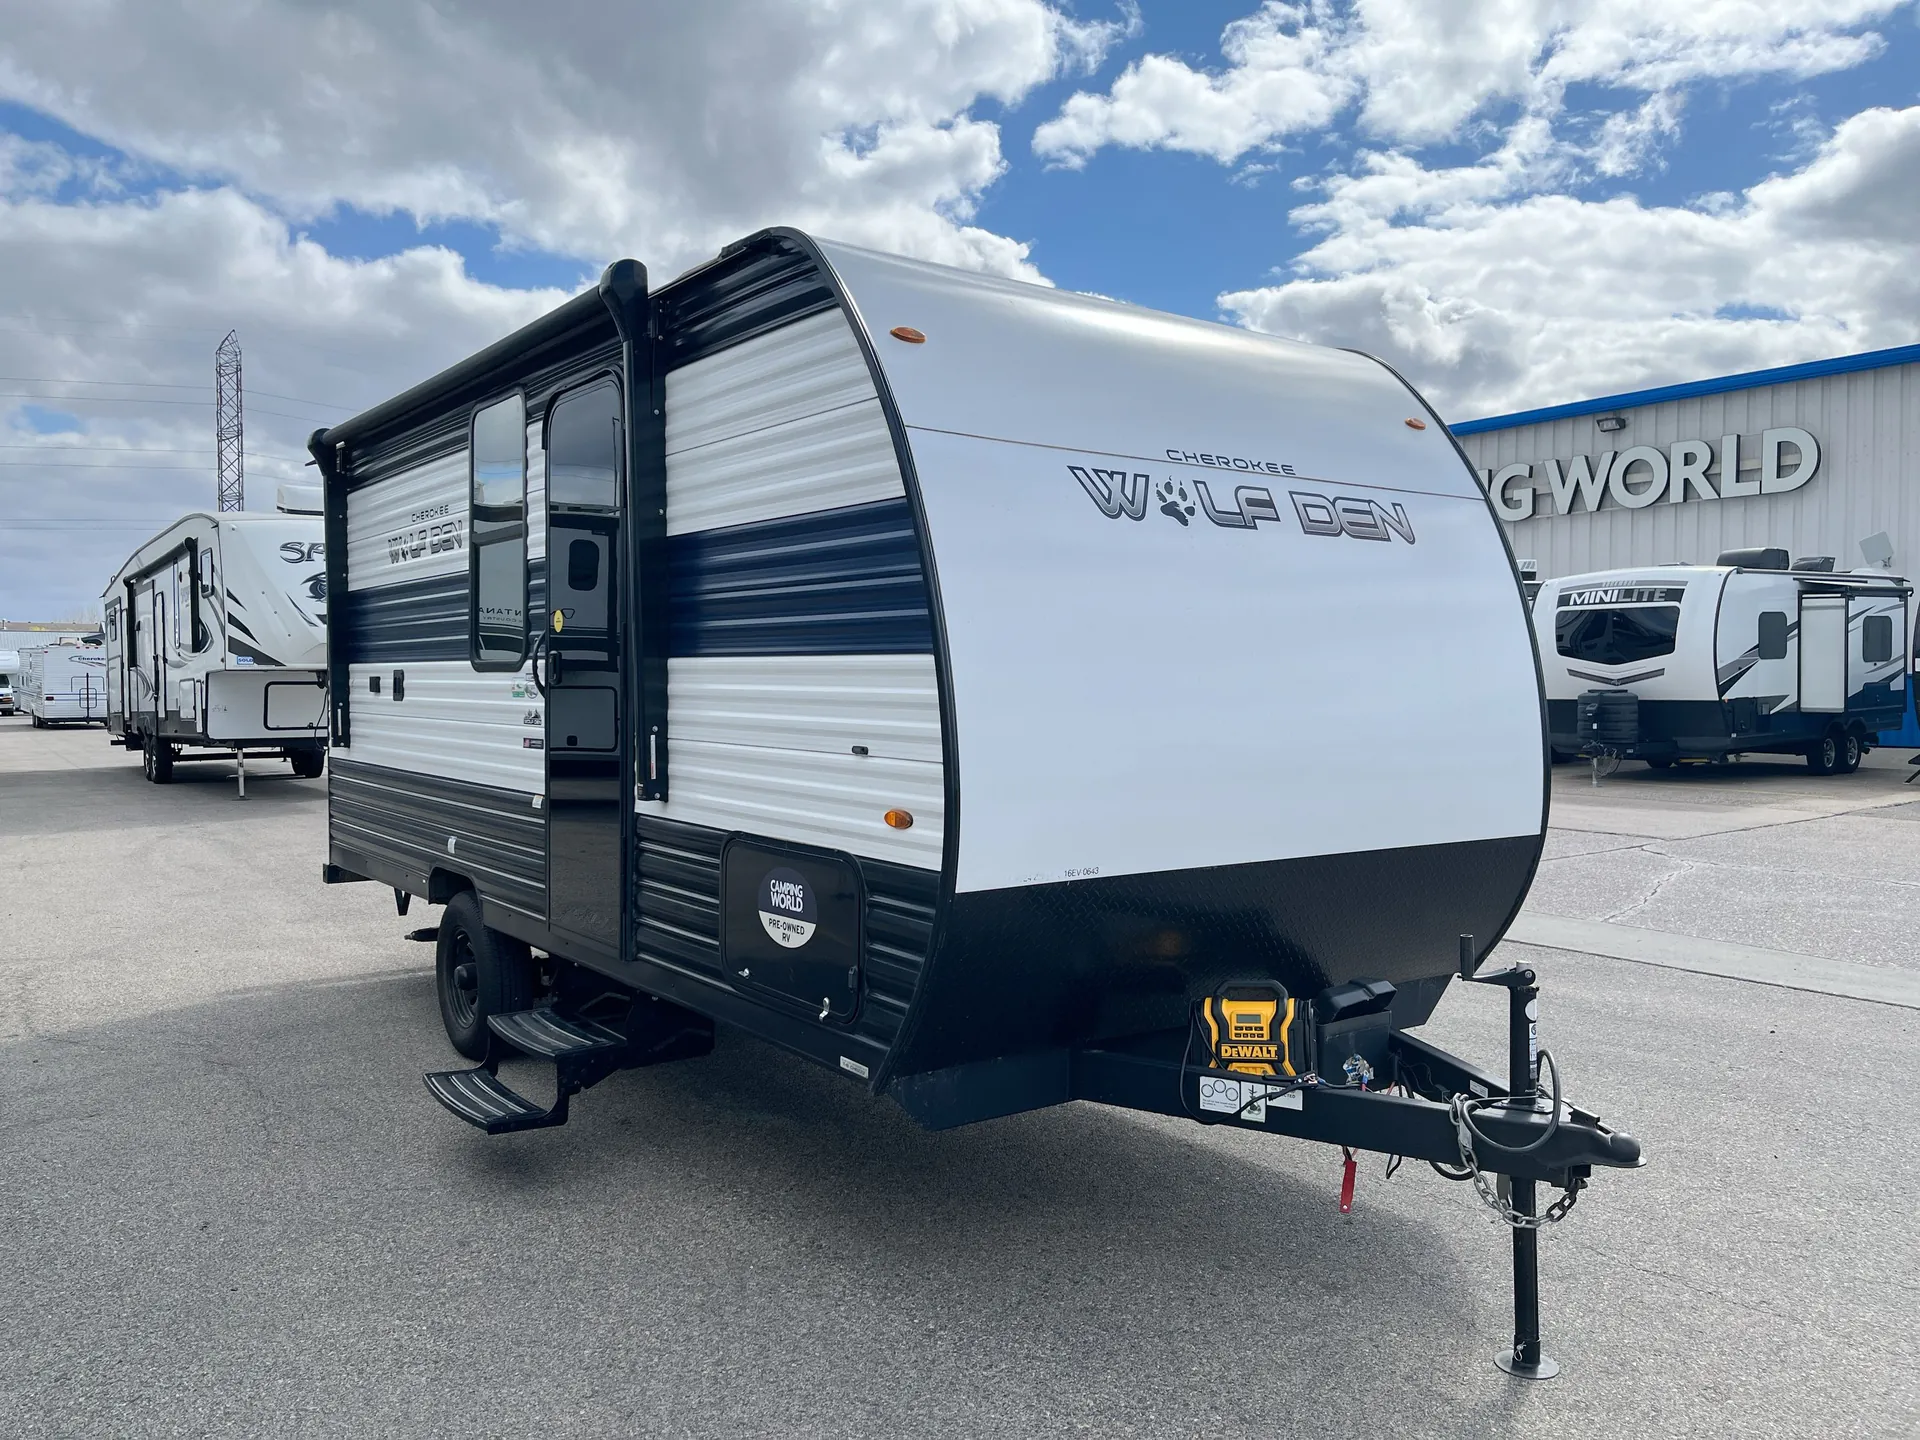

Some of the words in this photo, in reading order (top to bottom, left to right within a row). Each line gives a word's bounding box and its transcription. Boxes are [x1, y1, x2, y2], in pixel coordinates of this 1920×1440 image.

[1166, 449, 1296, 476] CHEROKEE
[1544, 426, 1822, 515] WORLD
[411, 504, 449, 523] CHEROKEE
[1288, 490, 1416, 545] DEN
[430, 520, 463, 554] DEN
[1064, 868, 1082, 877] 16EV
[770, 879, 803, 898] CAMPING
[770, 892, 804, 913] WORLD
[768, 917, 805, 935] PRE-OWNED
[781, 933, 791, 943] RV
